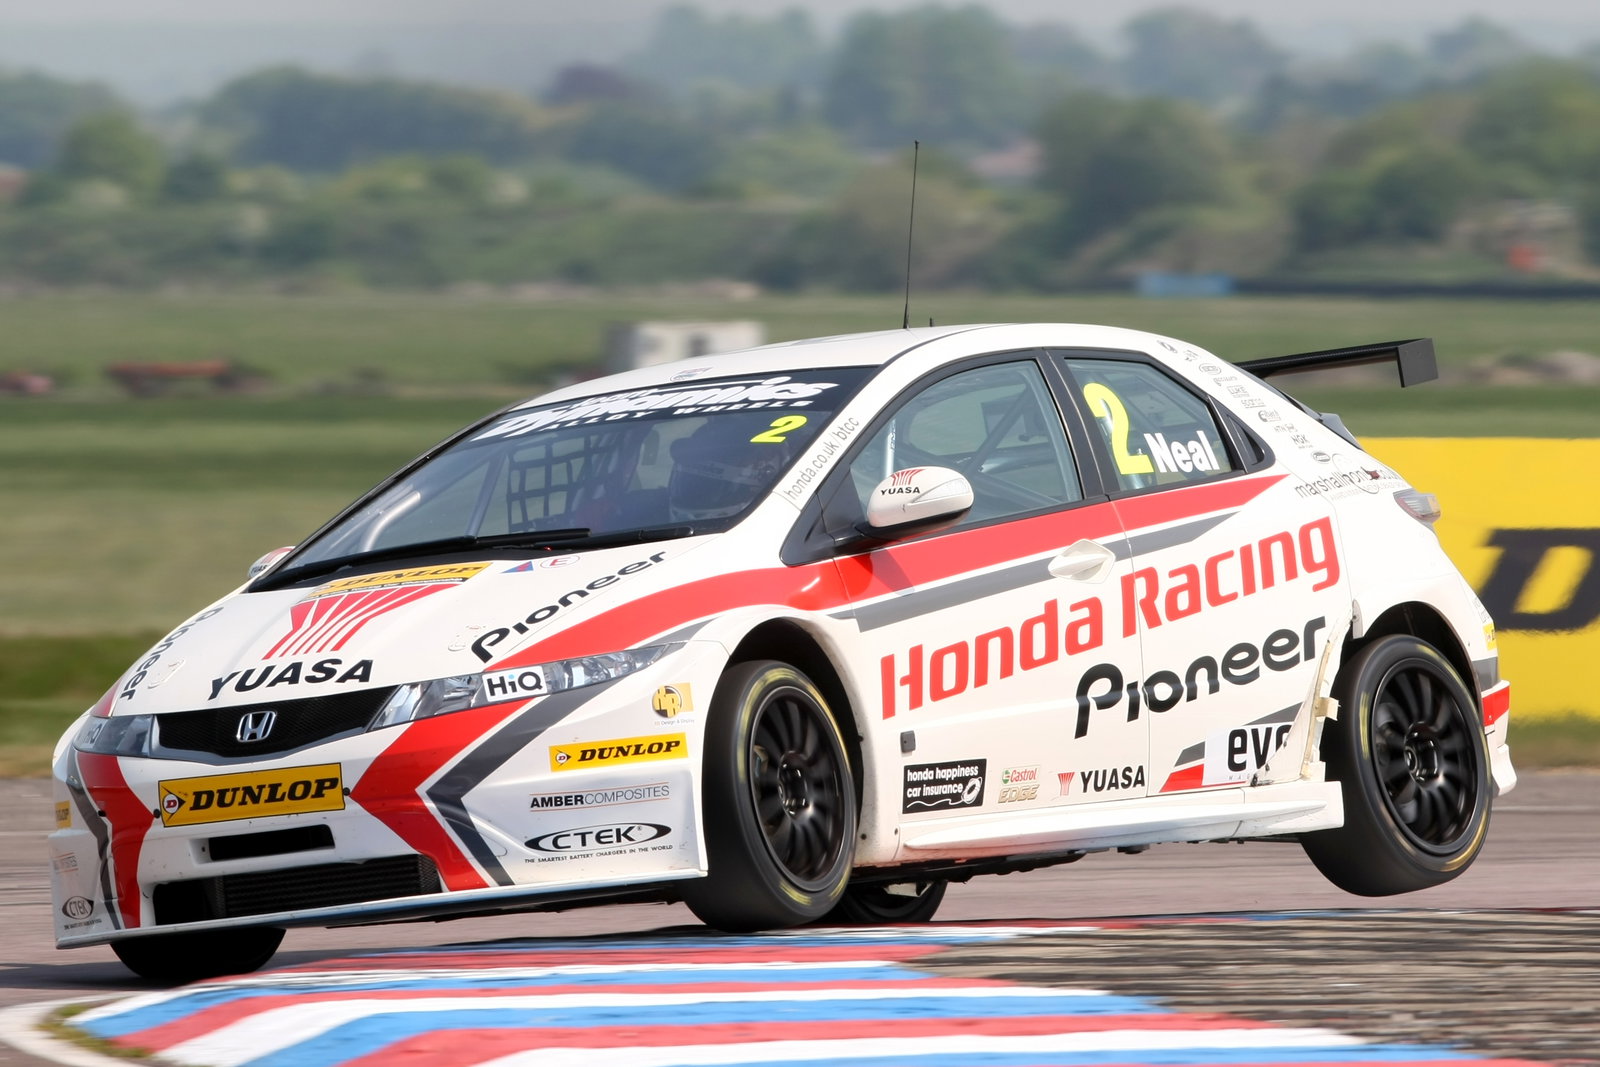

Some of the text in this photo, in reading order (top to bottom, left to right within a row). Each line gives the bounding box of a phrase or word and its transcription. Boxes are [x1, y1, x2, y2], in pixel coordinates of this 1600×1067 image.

[672, 400, 814, 416] WHEELS
[750, 414, 808, 444] 2
[1083, 382, 1154, 475] 2
[1143, 430, 1220, 473] Neal
[880, 486, 921, 496] YUASA
[470, 551, 667, 664] Pioneer
[880, 516, 1340, 720] Honda Racing
[119, 606, 225, 701] Pioneer
[208, 657, 374, 701] YUASA
[486, 671, 543, 697] HiQ
[1074, 616, 1326, 739] Pioneer
[578, 740, 680, 762] DUNLOP
[907, 765, 979, 782] honda happiness
[1010, 767, 1037, 783] Castrol
[1081, 765, 1145, 793] YUASA
[189, 777, 339, 811] DUNLOP
[907, 783, 964, 798] car insurance
[998, 784, 1040, 803] EDGE
[552, 826, 636, 850] CTEK
[595, 849, 627, 858] CHARGERS
[651, 844, 674, 852] WORLD
